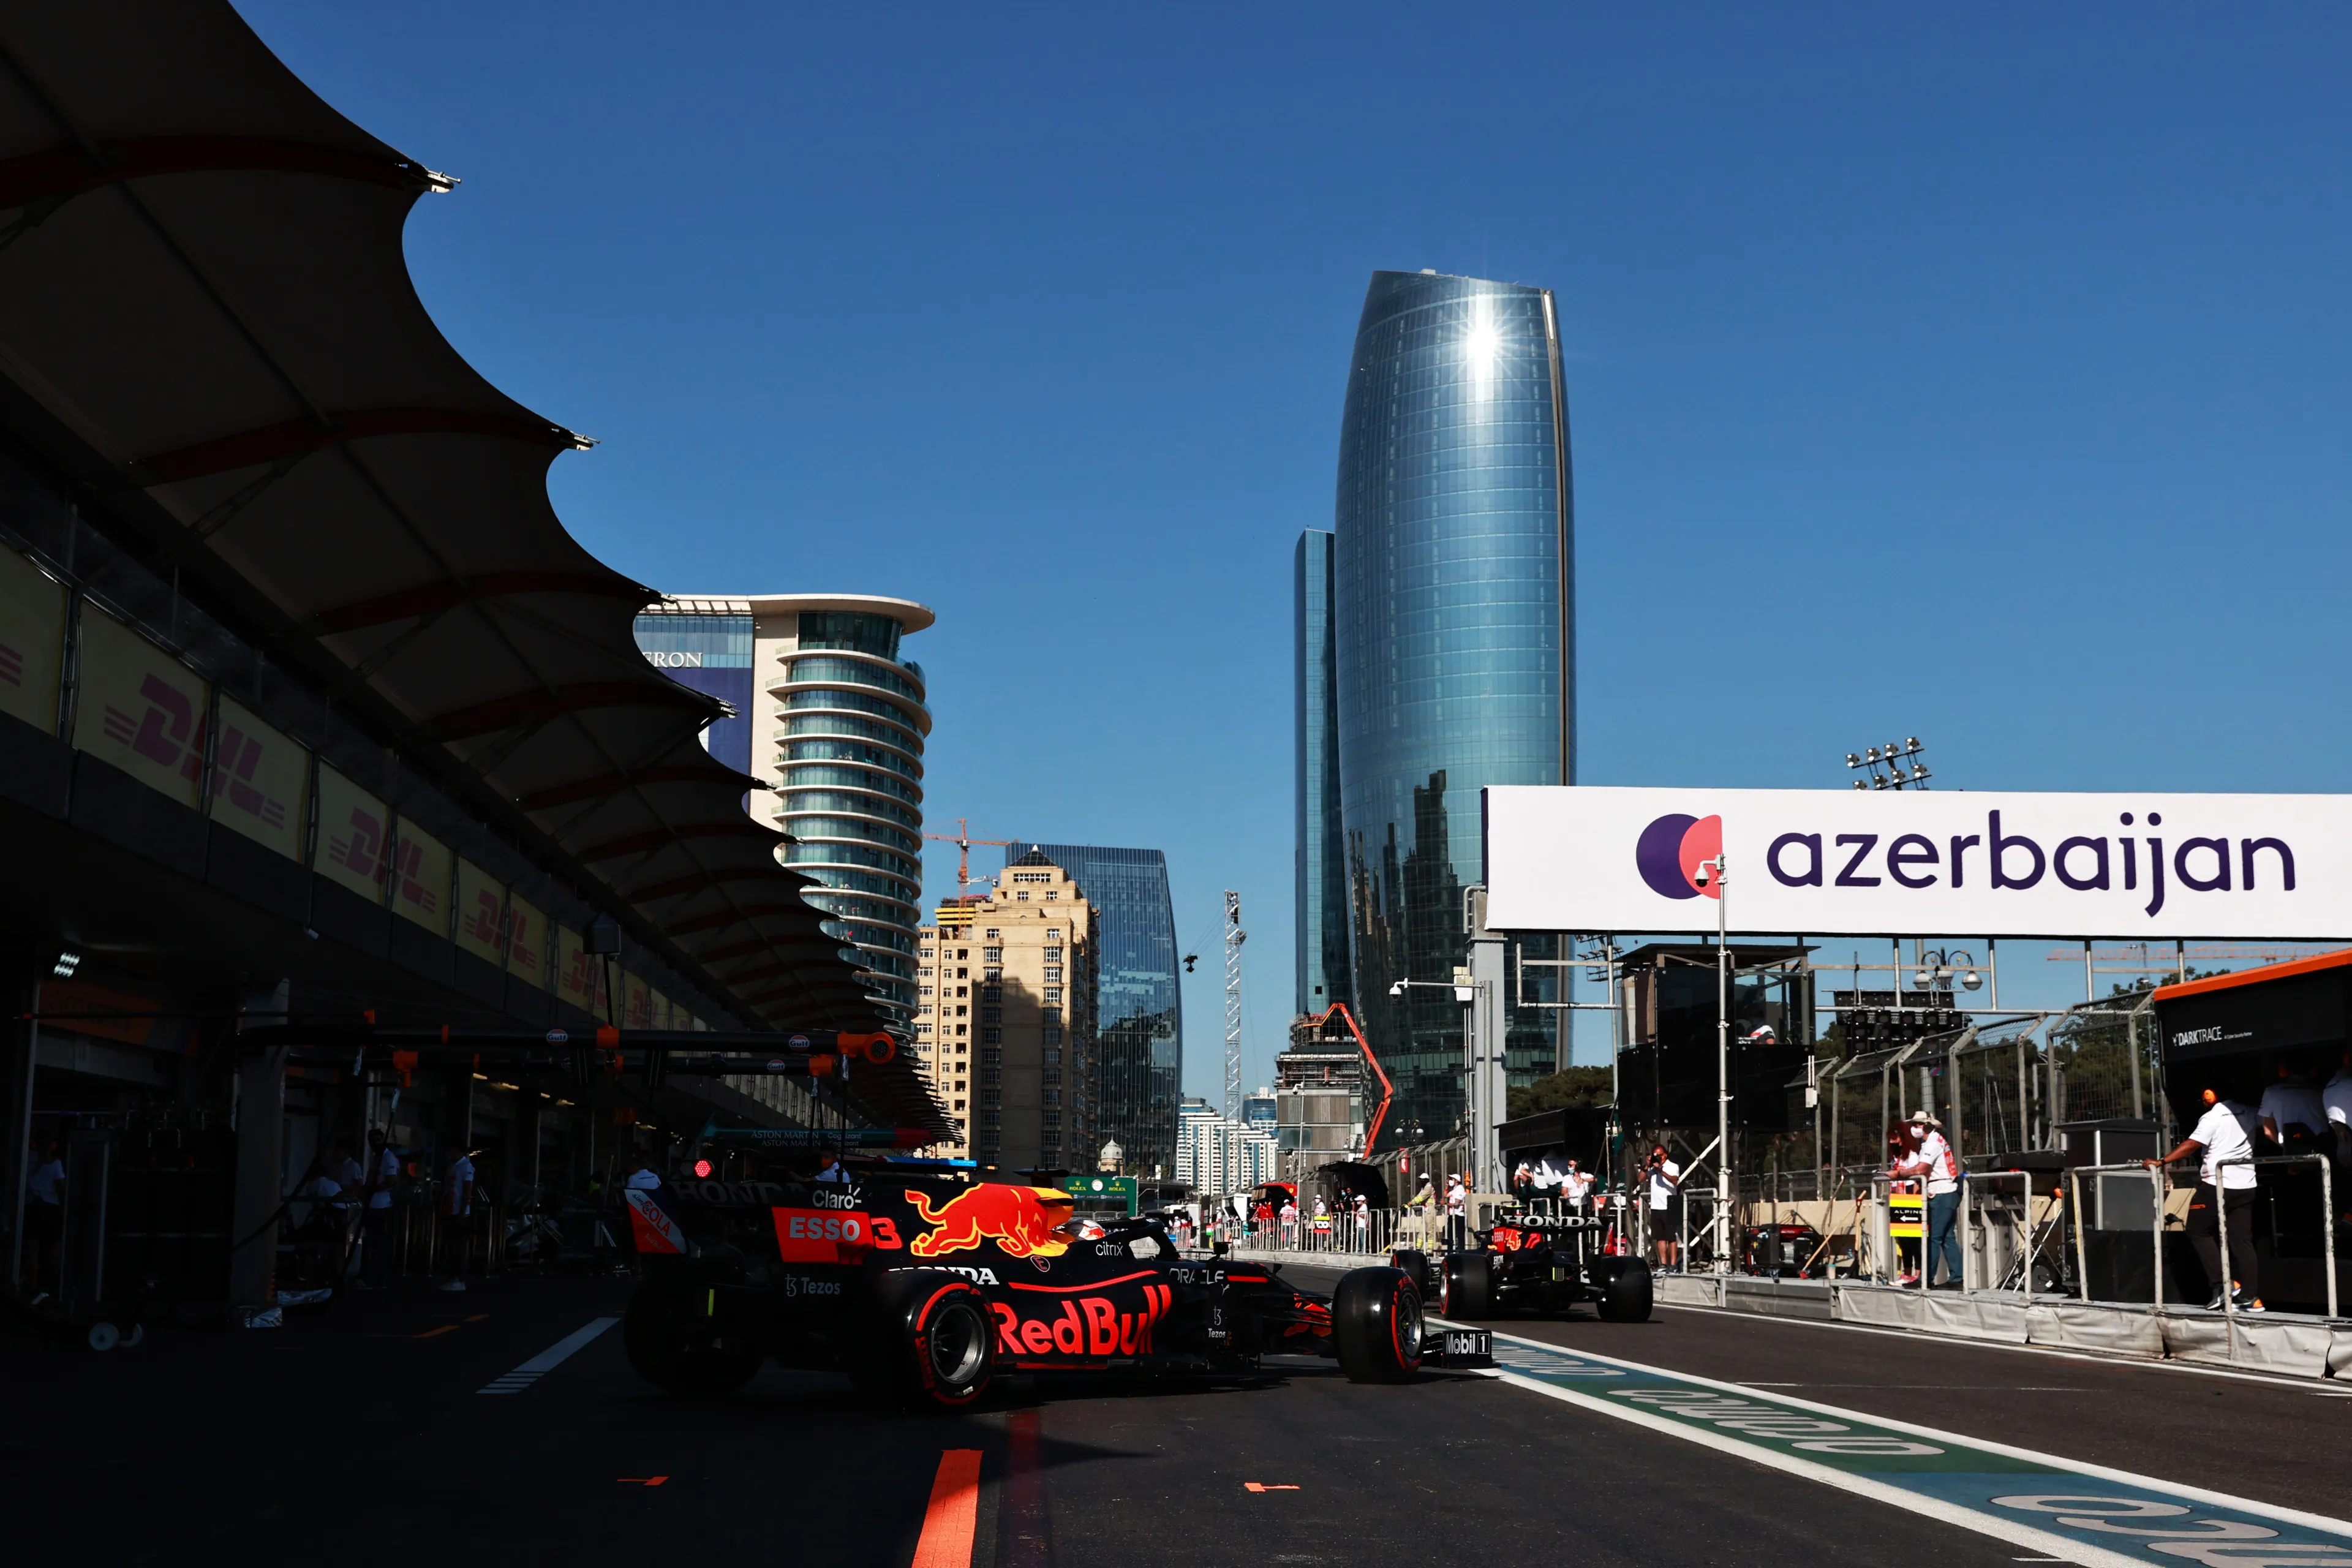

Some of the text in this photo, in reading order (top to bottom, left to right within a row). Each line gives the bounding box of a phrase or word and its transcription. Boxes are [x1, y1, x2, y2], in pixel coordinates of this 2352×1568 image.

[132, 673, 265, 817] DHL
[345, 806, 424, 905] DHL
[1766, 810, 2296, 918] azerbaijan
[475, 888, 528, 963] DHL
[2179, 1026, 2222, 1046] DARKTRACE
[812, 1189, 855, 1210] Claro
[642, 1200, 671, 1237] COLA
[790, 1216, 861, 1242] ESSO
[1502, 1215, 1604, 1227] HONDA
[1095, 1241, 1123, 1257] citrix
[801, 1276, 842, 1295] Tezos
[1208, 1328, 1226, 1338] Tezos
[1446, 1333, 1476, 1354] Mobil
